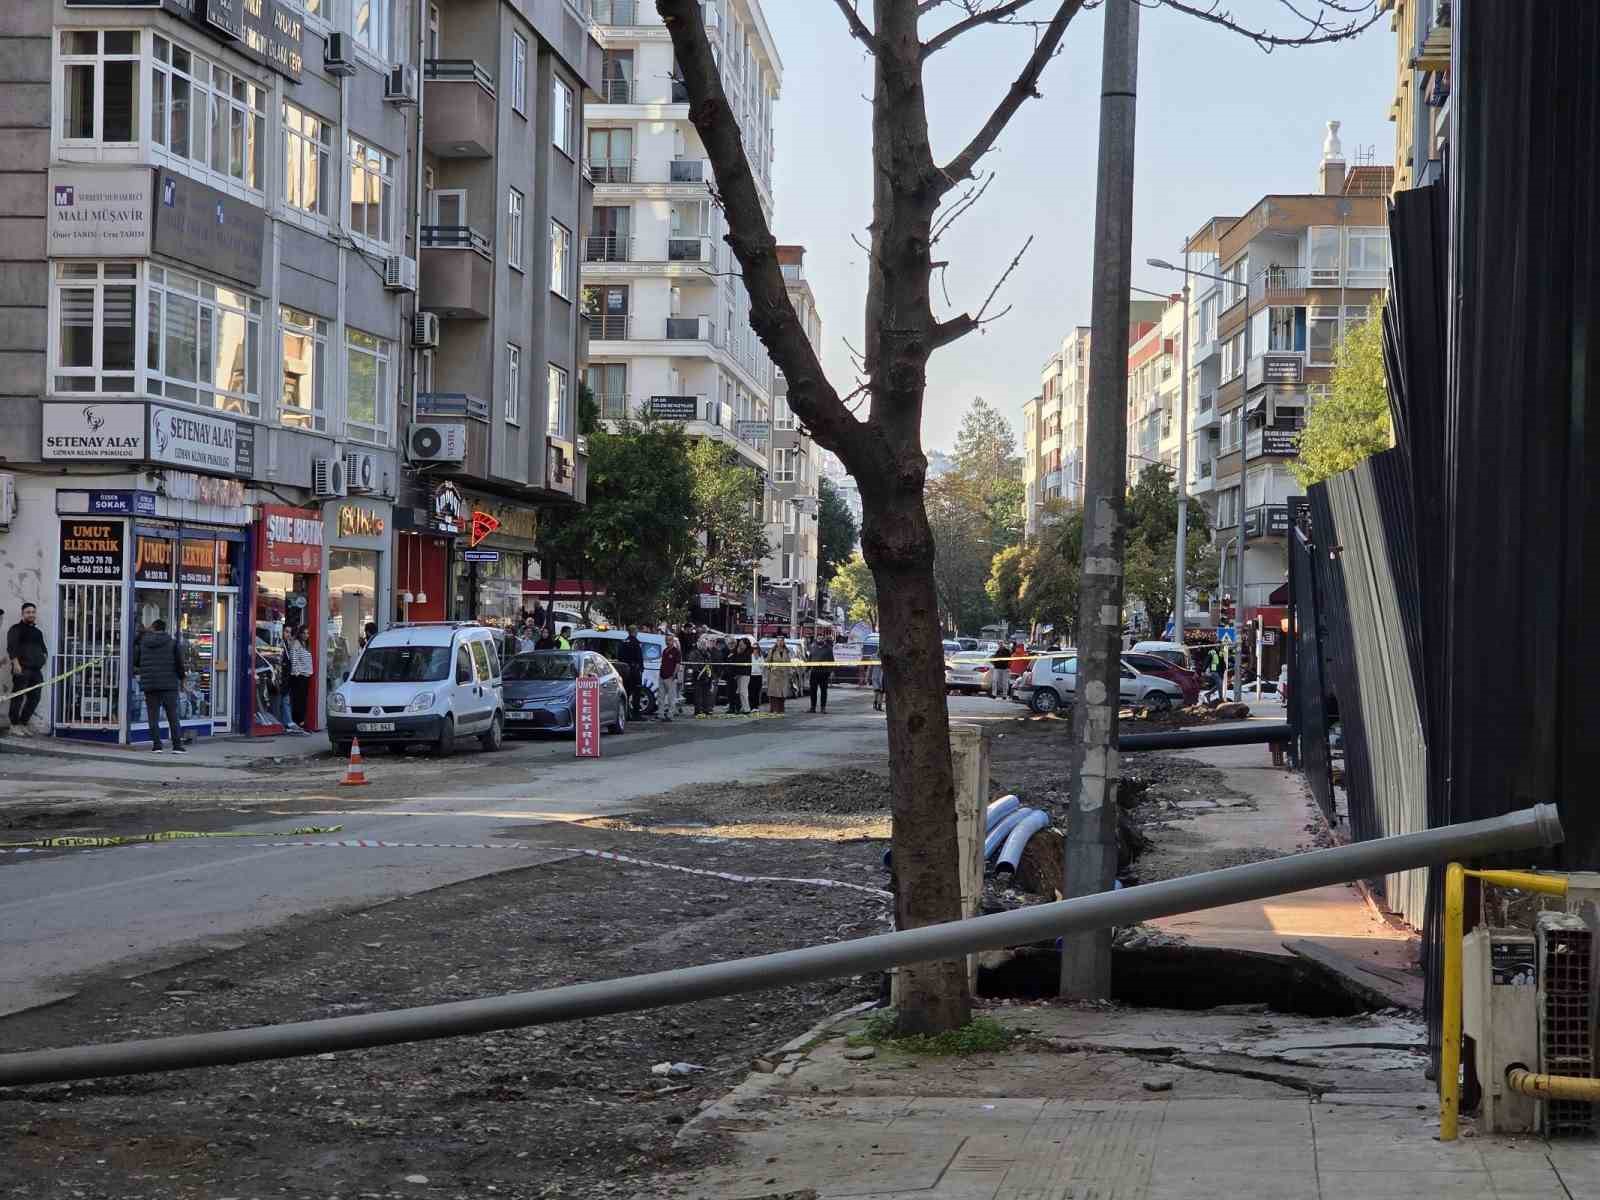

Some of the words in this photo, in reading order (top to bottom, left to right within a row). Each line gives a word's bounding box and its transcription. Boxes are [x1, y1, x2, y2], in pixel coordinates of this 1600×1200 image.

[58, 208, 88, 221] MALİ
[92, 208, 143, 222] MÜŞAVİR
[171, 417, 210, 445] SETENAY
[211, 425, 233, 448] ALAY
[47, 437, 104, 447] SETENAY
[107, 437, 139, 447] ALAY
[95, 501, 127, 509] SOKAK
[73, 526, 111, 538] UMUT
[64, 538, 119, 551] ELEKTRİK
[144, 542, 171, 564] UMUT
[578, 681, 597, 689] UMUT
